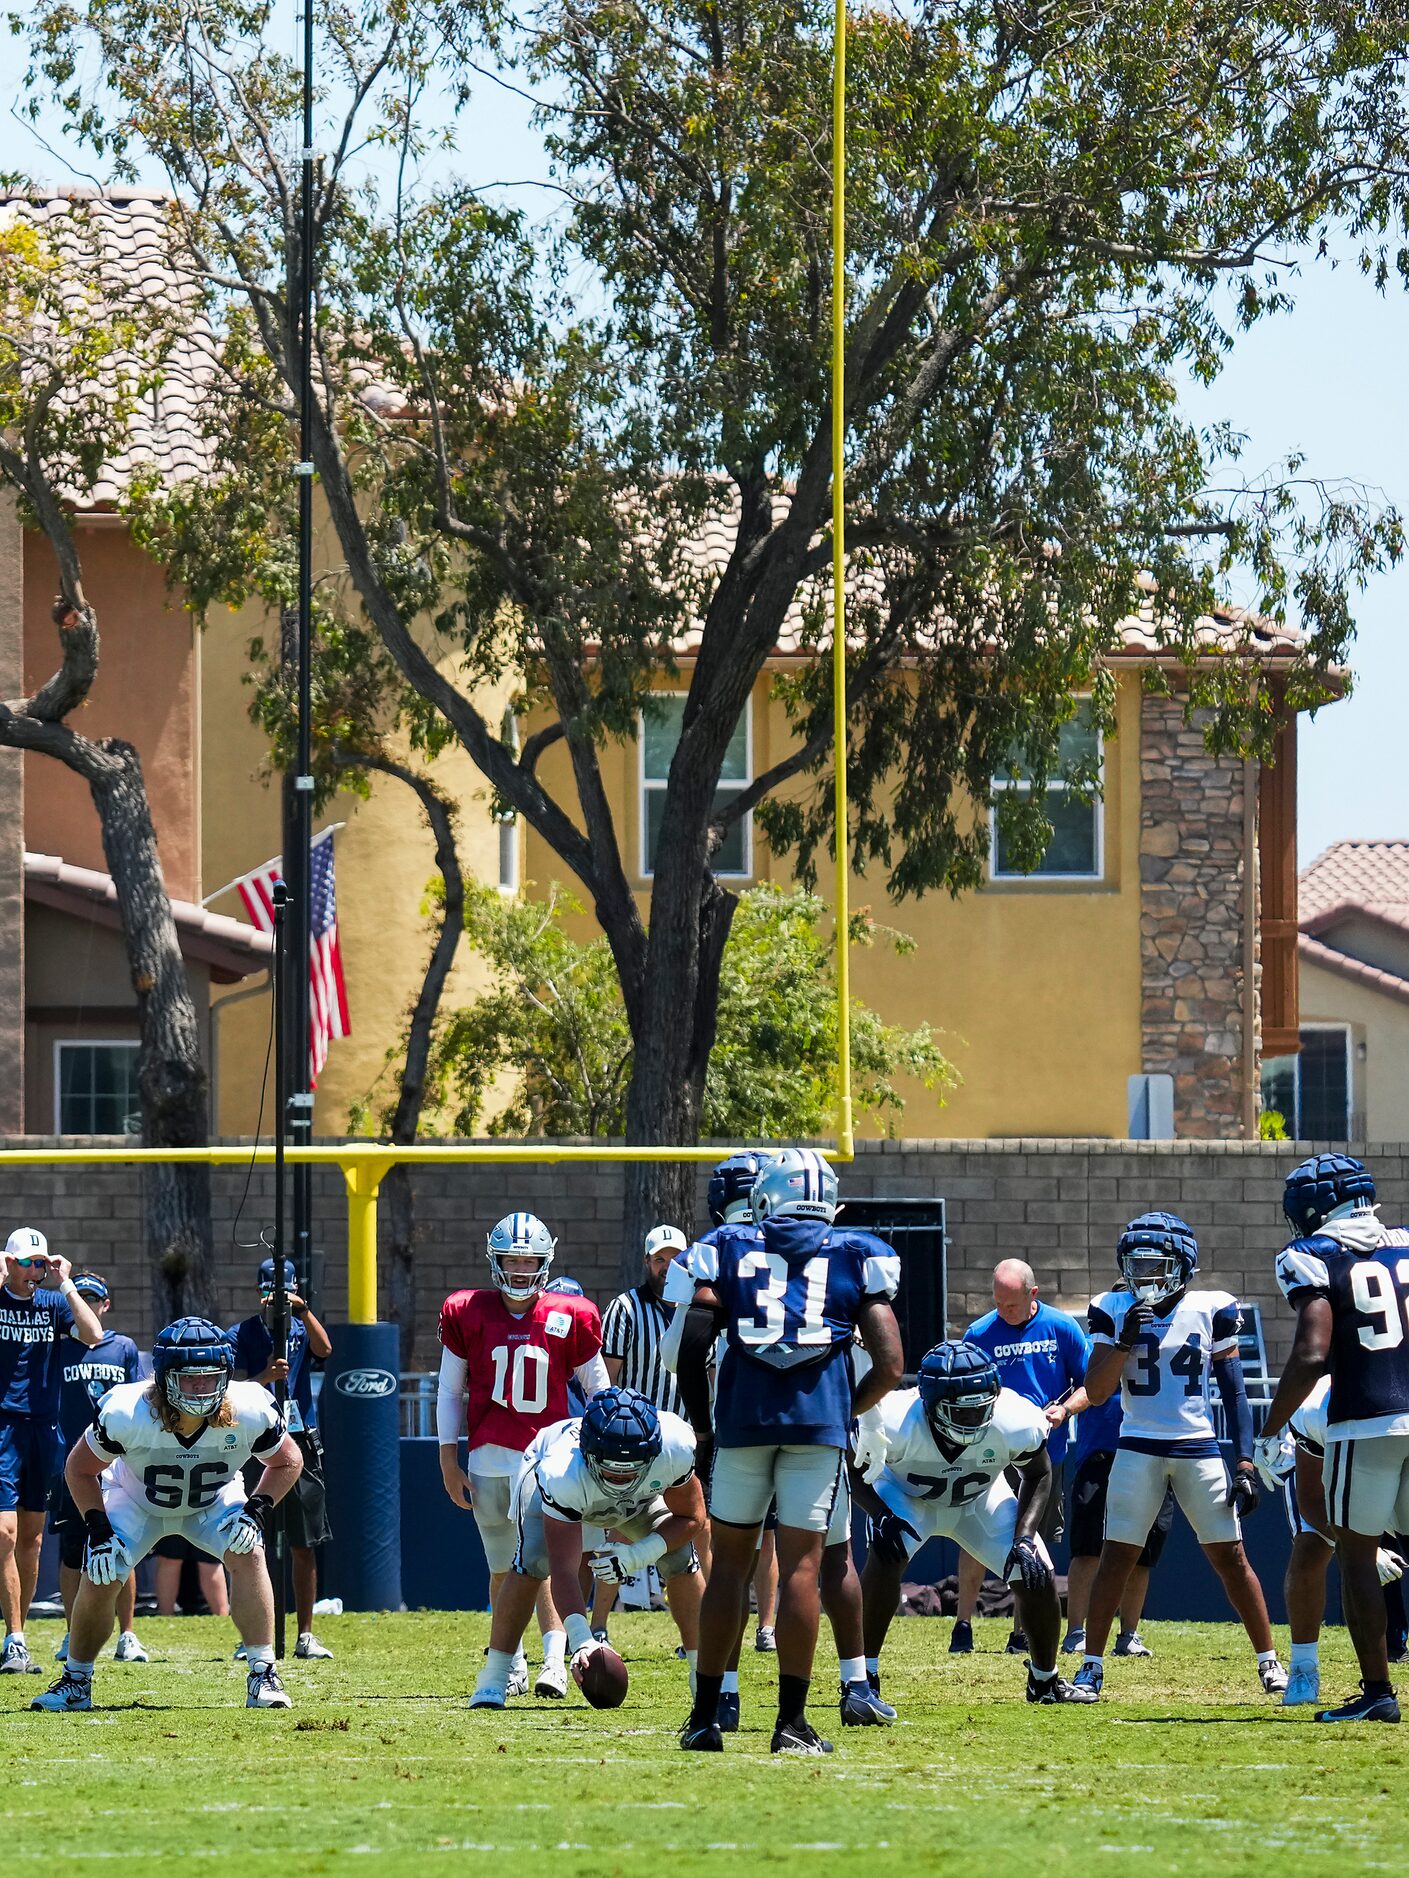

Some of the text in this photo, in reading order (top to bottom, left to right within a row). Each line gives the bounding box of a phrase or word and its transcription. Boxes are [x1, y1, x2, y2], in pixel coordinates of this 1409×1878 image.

[737, 1251, 832, 1344] 31
[0, 1308, 50, 1325] DALLAS
[994, 1339, 1058, 1358] COWBOYS
[1119, 1331, 1203, 1396] 34
[63, 1363, 126, 1383] COWBOYS
[345, 1372, 389, 1393] Ford
[491, 1344, 549, 1413] 10
[143, 1461, 229, 1509] 66
[906, 1472, 991, 1508] 76
